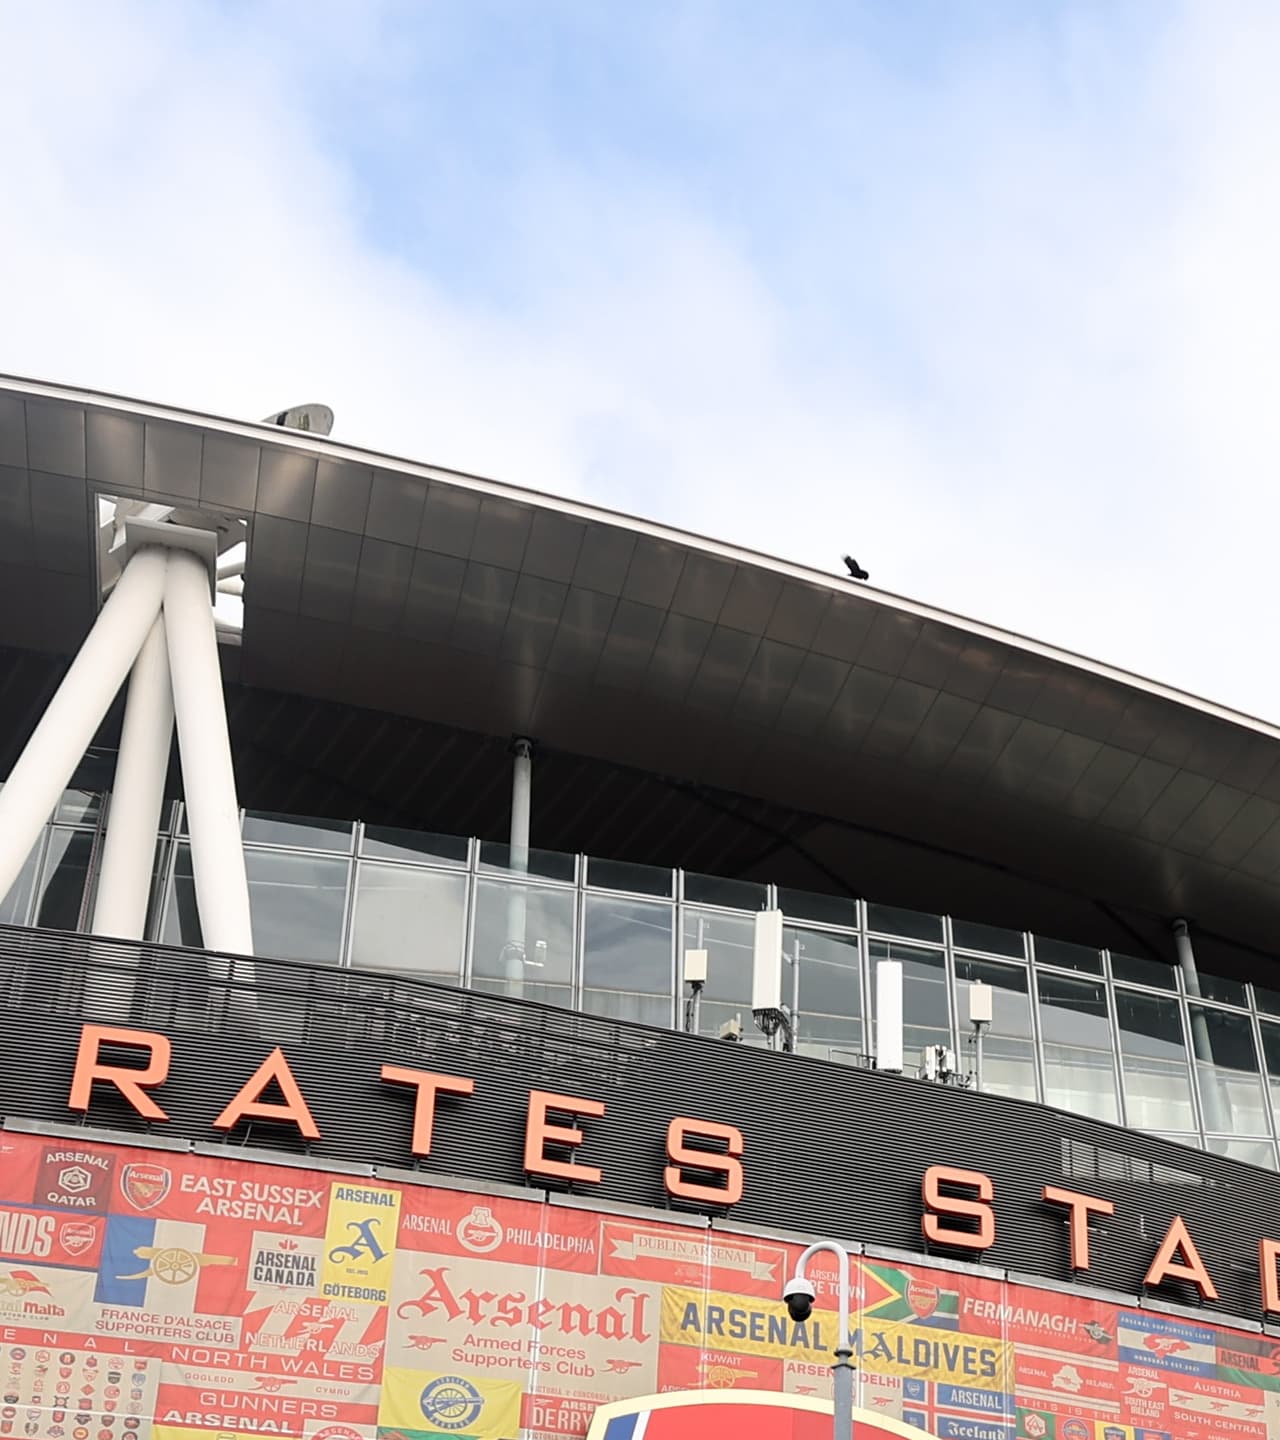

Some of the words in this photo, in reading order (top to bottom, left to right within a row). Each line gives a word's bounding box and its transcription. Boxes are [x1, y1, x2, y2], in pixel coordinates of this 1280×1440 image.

[336, 1188, 396, 1207] ARSENAL
[402, 1214, 452, 1235] ARSENAL
[506, 1229, 595, 1254] PHILADELPHIA
[256, 1251, 316, 1272] ARSENAL
[254, 1268, 315, 1287] CANADA
[323, 1283, 386, 1302] GÖTEBORG
[397, 1268, 651, 1343] Arsenal
[964, 1298, 1077, 1333] FERMANAGH
[463, 1334, 521, 1351] Armed
[528, 1341, 586, 1359] Forces
[681, 1302, 827, 1351] ARSENAL
[846, 1330, 996, 1376] MALDIVES
[451, 1349, 550, 1371] Supporters
[555, 1361, 596, 1378] Club
[950, 1389, 1002, 1409] ARSENAL
[163, 1410, 294, 1433] ARSENAL
[947, 1421, 1005, 1440] Iceland
